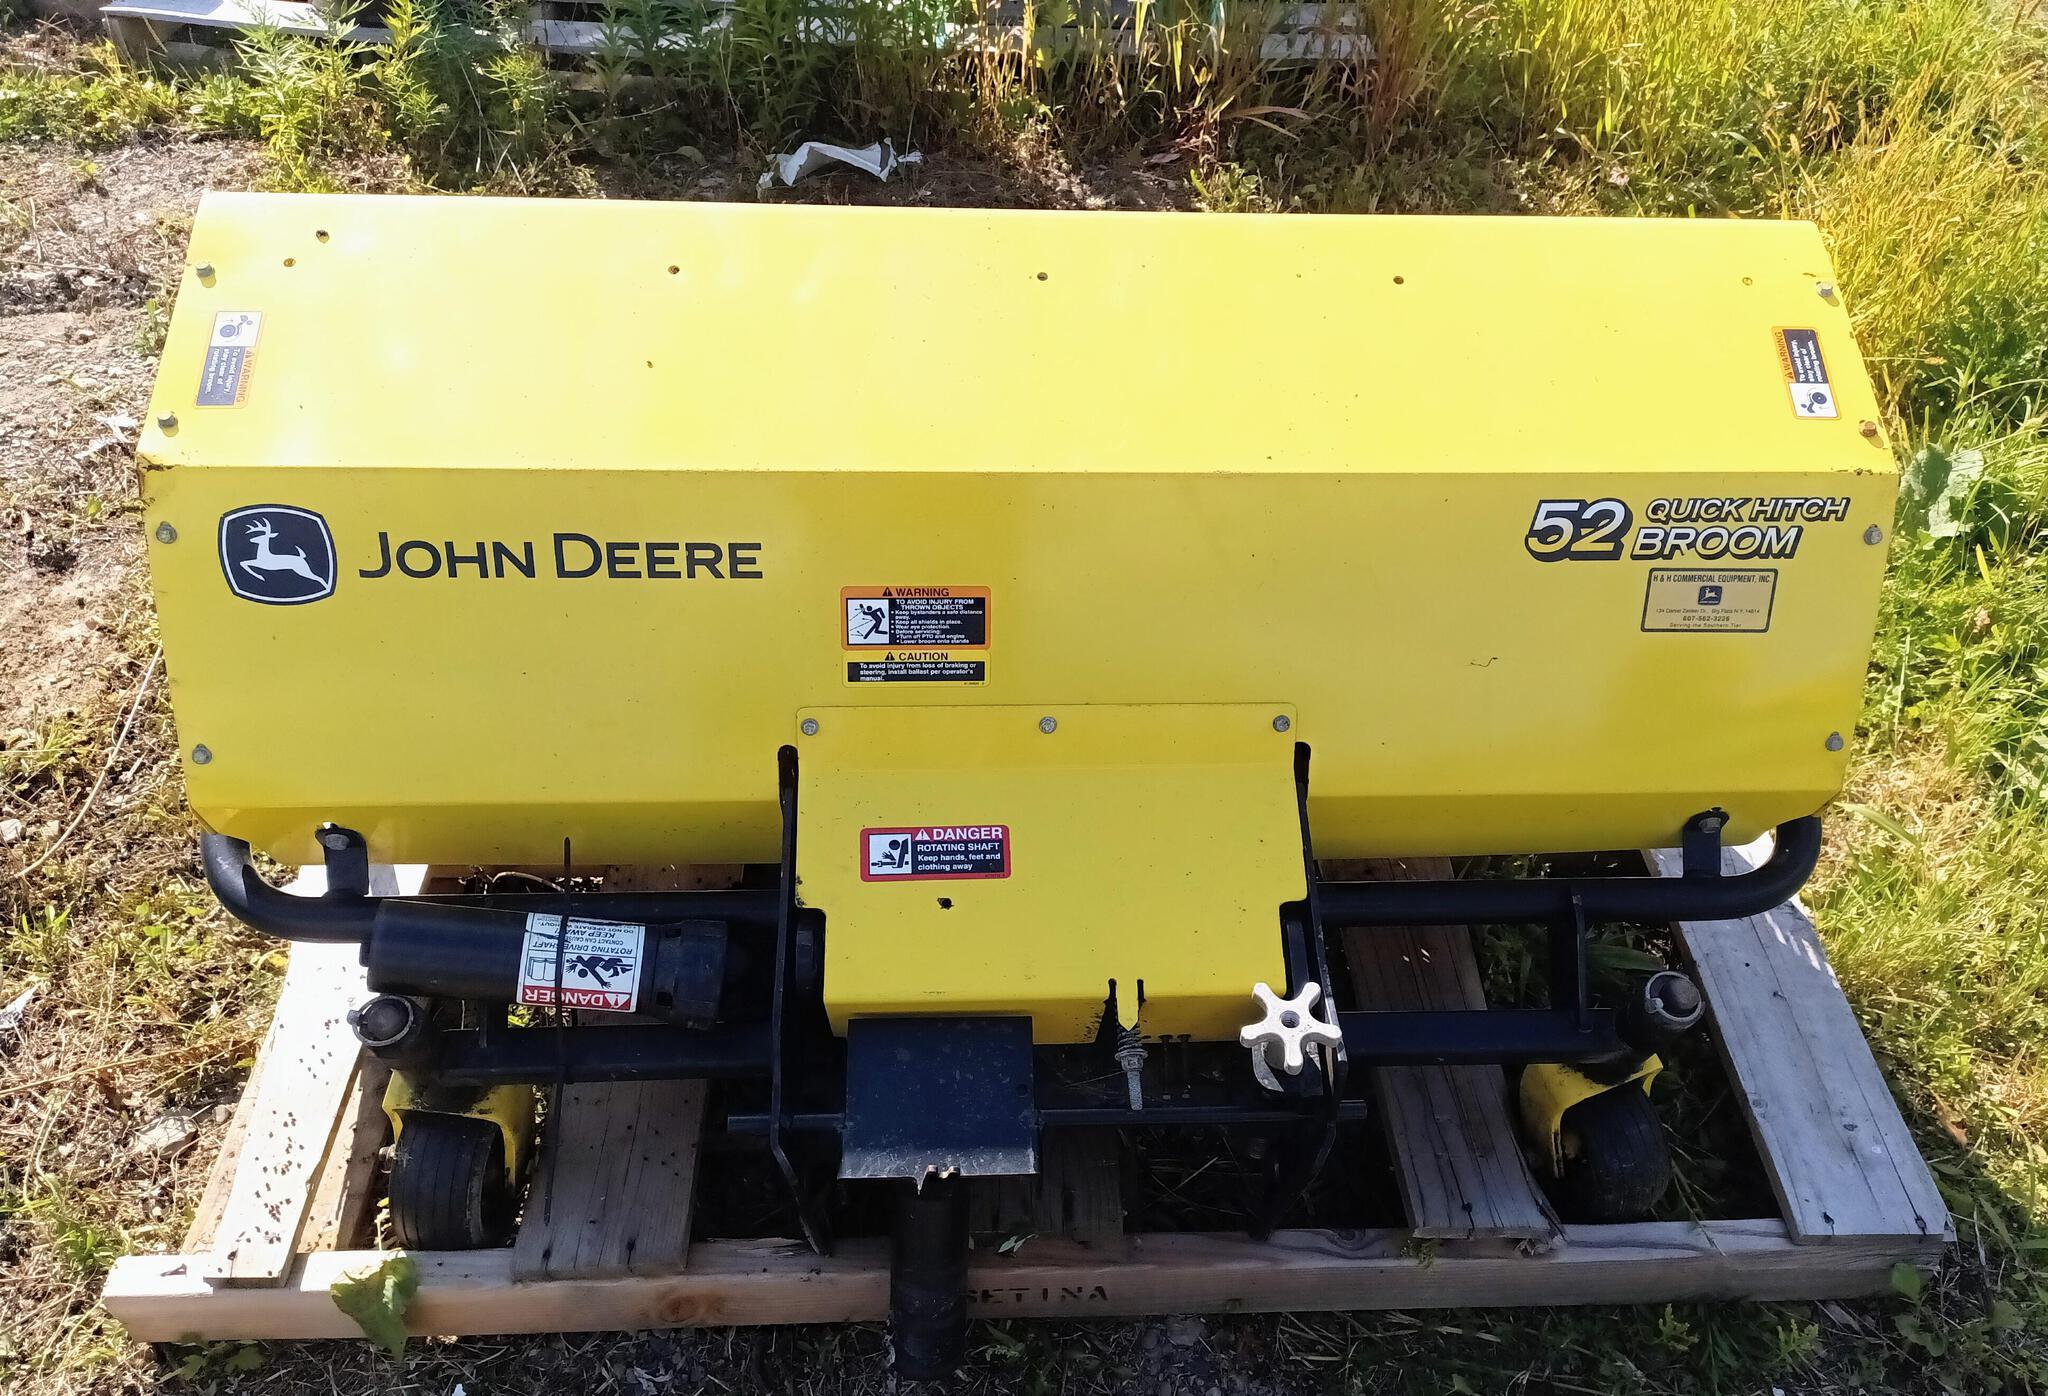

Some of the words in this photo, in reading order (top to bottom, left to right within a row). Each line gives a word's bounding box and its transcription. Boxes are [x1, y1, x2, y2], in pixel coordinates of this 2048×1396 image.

[220, 348, 229, 361] stay
[233, 348, 240, 356] To
[1774, 331, 1791, 370] WARNING
[209, 348, 220, 372] rotating
[229, 358, 237, 373] avoid
[1795, 358, 1804, 373] avoid
[1803, 355, 1811, 368] clear
[219, 362, 227, 377] clear
[1812, 361, 1823, 382] rotating
[236, 360, 252, 403] WARNING
[1799, 374, 1806, 382] To
[1525, 498, 1633, 562] 52
[1645, 498, 1752, 523] QUICK
[1749, 497, 1850, 523] HITCH
[1630, 526, 1803, 560] BROOM
[359, 532, 536, 579] JOHN
[553, 533, 763, 579] DEERE
[1718, 575, 1757, 583] EQUIPMENT,
[896, 588, 949, 596] WARNING
[899, 653, 948, 661] CAUTION
[933, 827, 1002, 840] DANGER
[917, 843, 964, 852] ROTATING
[968, 843, 999, 851] SHAFT
[918, 863, 950, 871] clothing
[952, 863, 972, 871] away
[589, 931, 616, 939] KEEP
[532, 941, 589, 951] DRIVEHAFT
[591, 945, 633, 955] ROTATING
